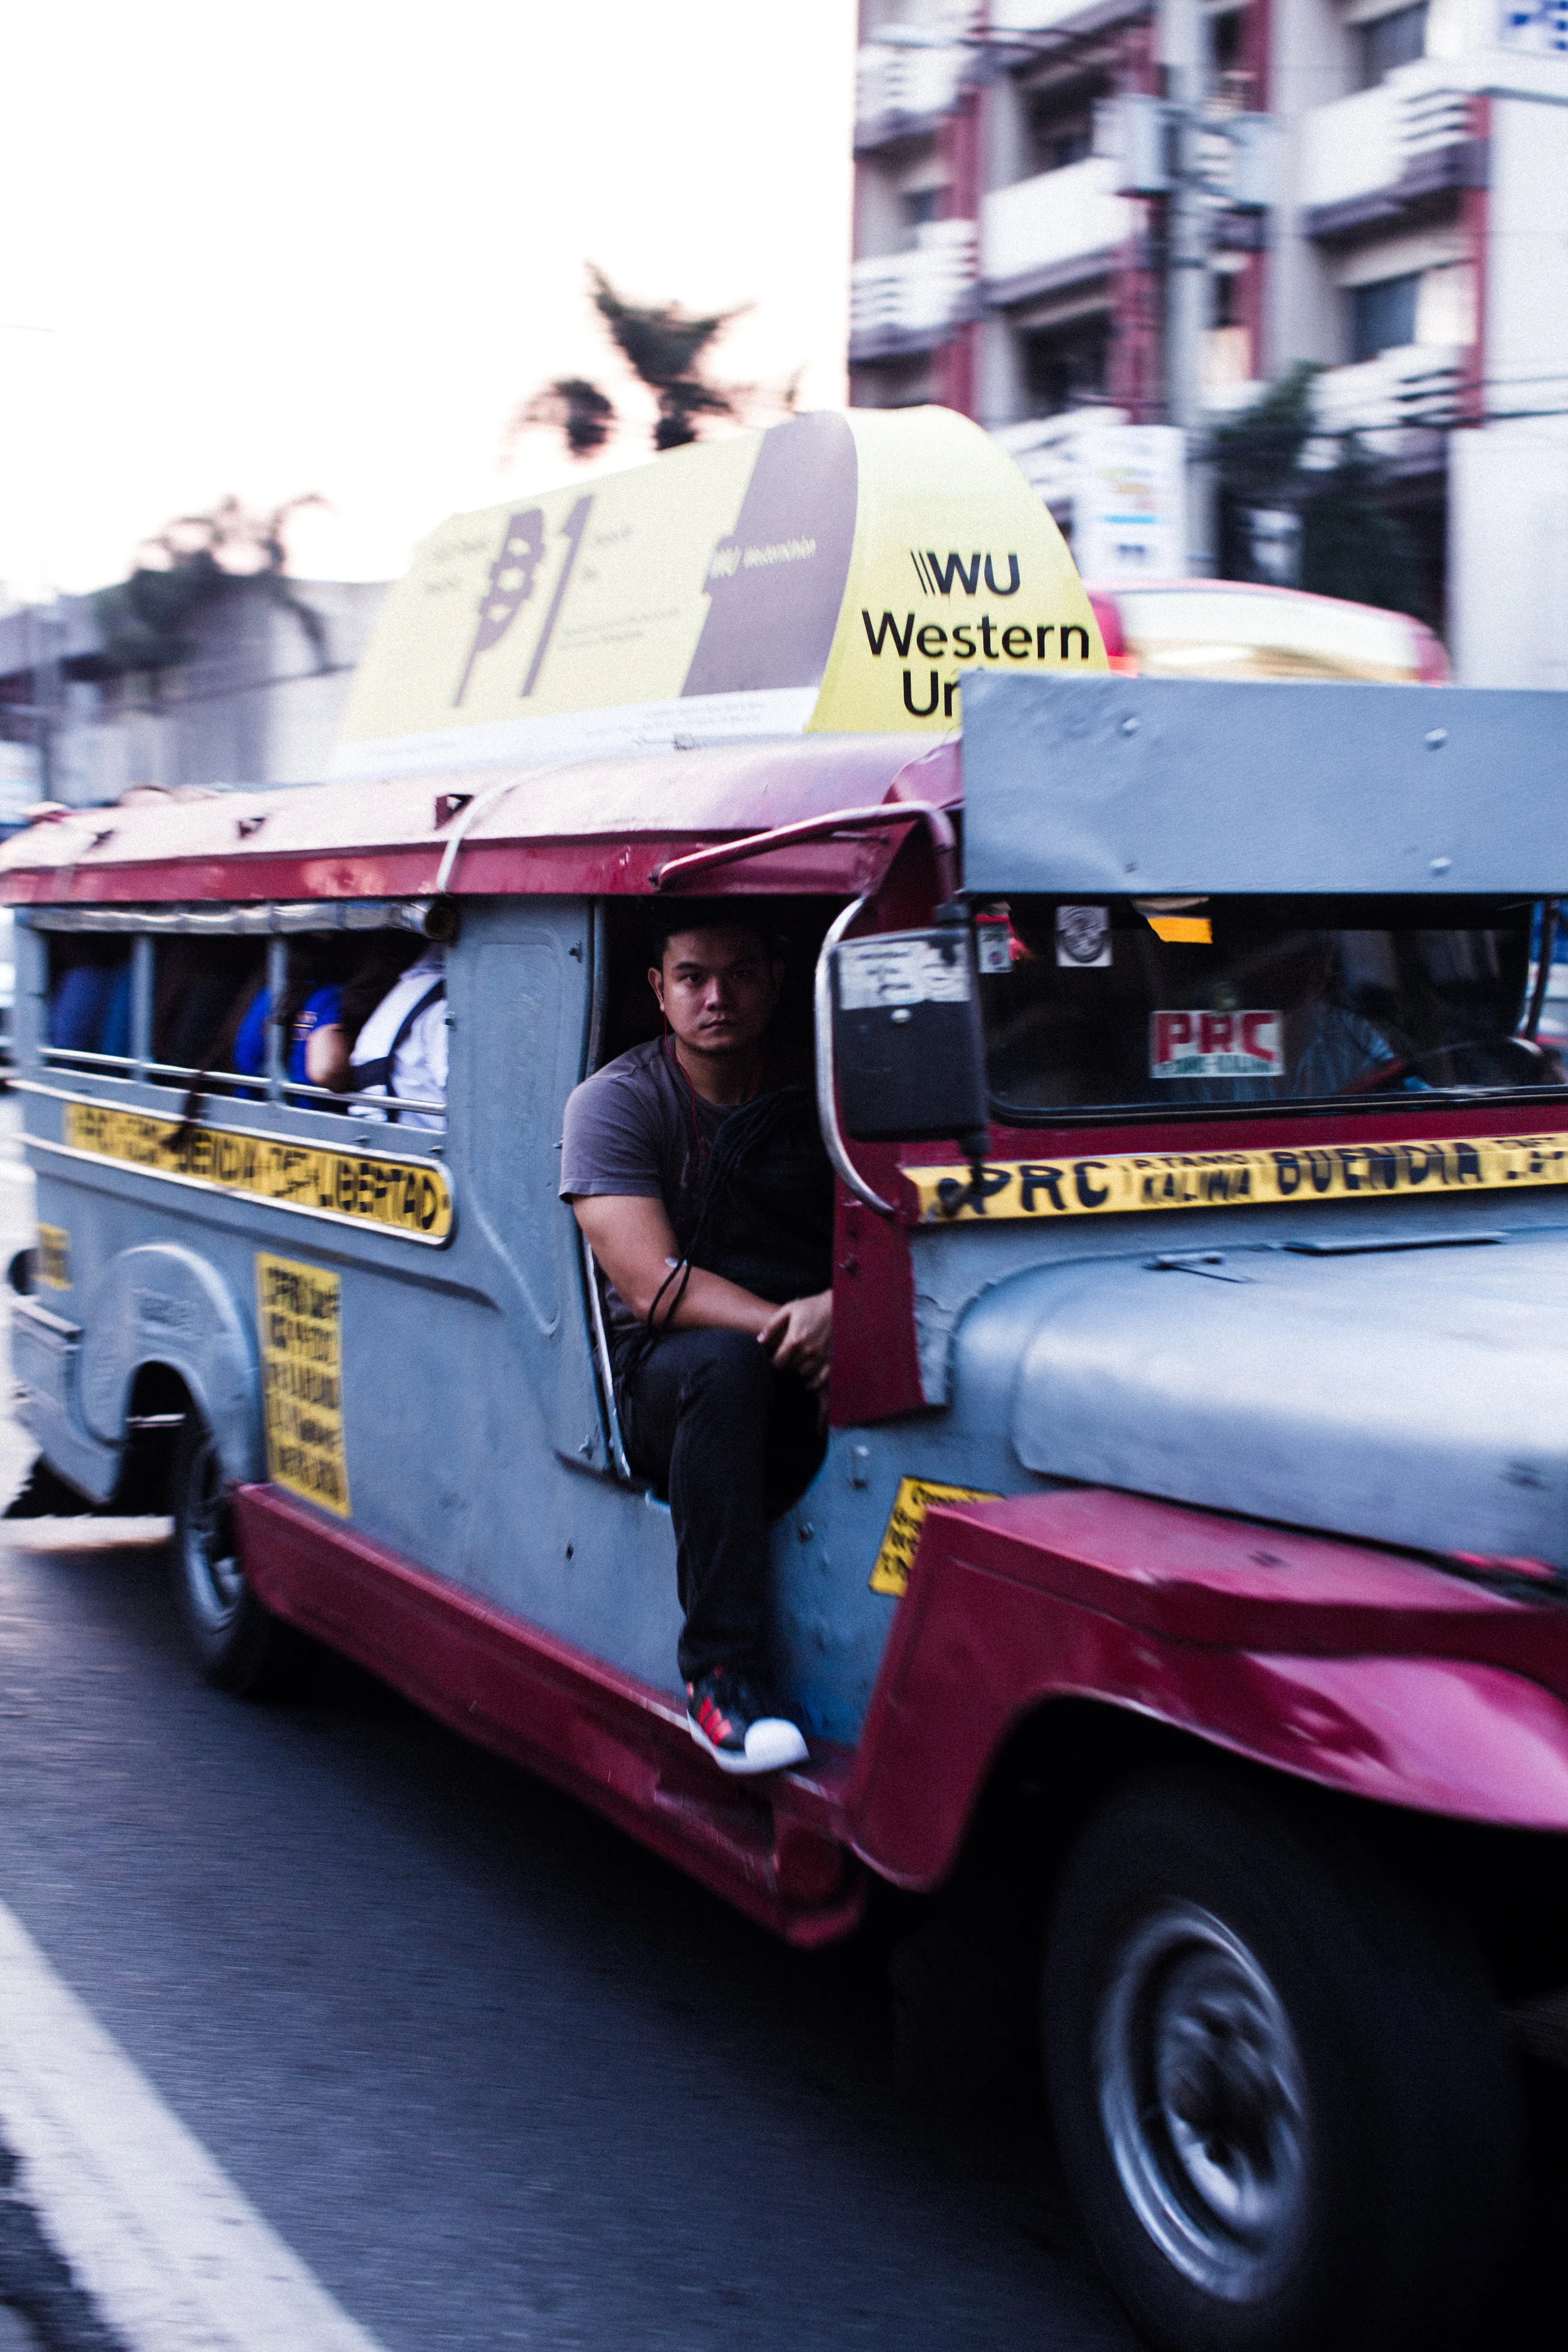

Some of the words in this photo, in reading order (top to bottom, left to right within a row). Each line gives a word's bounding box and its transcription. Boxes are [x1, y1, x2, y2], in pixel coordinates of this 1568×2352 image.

[911, 549, 1020, 596] WU
[861, 607, 1090, 660] Western
[1154, 1012, 1276, 1064] PRC
[970, 1160, 1109, 1216] PRC
[1271, 1142, 1484, 1195] BUENDIA
